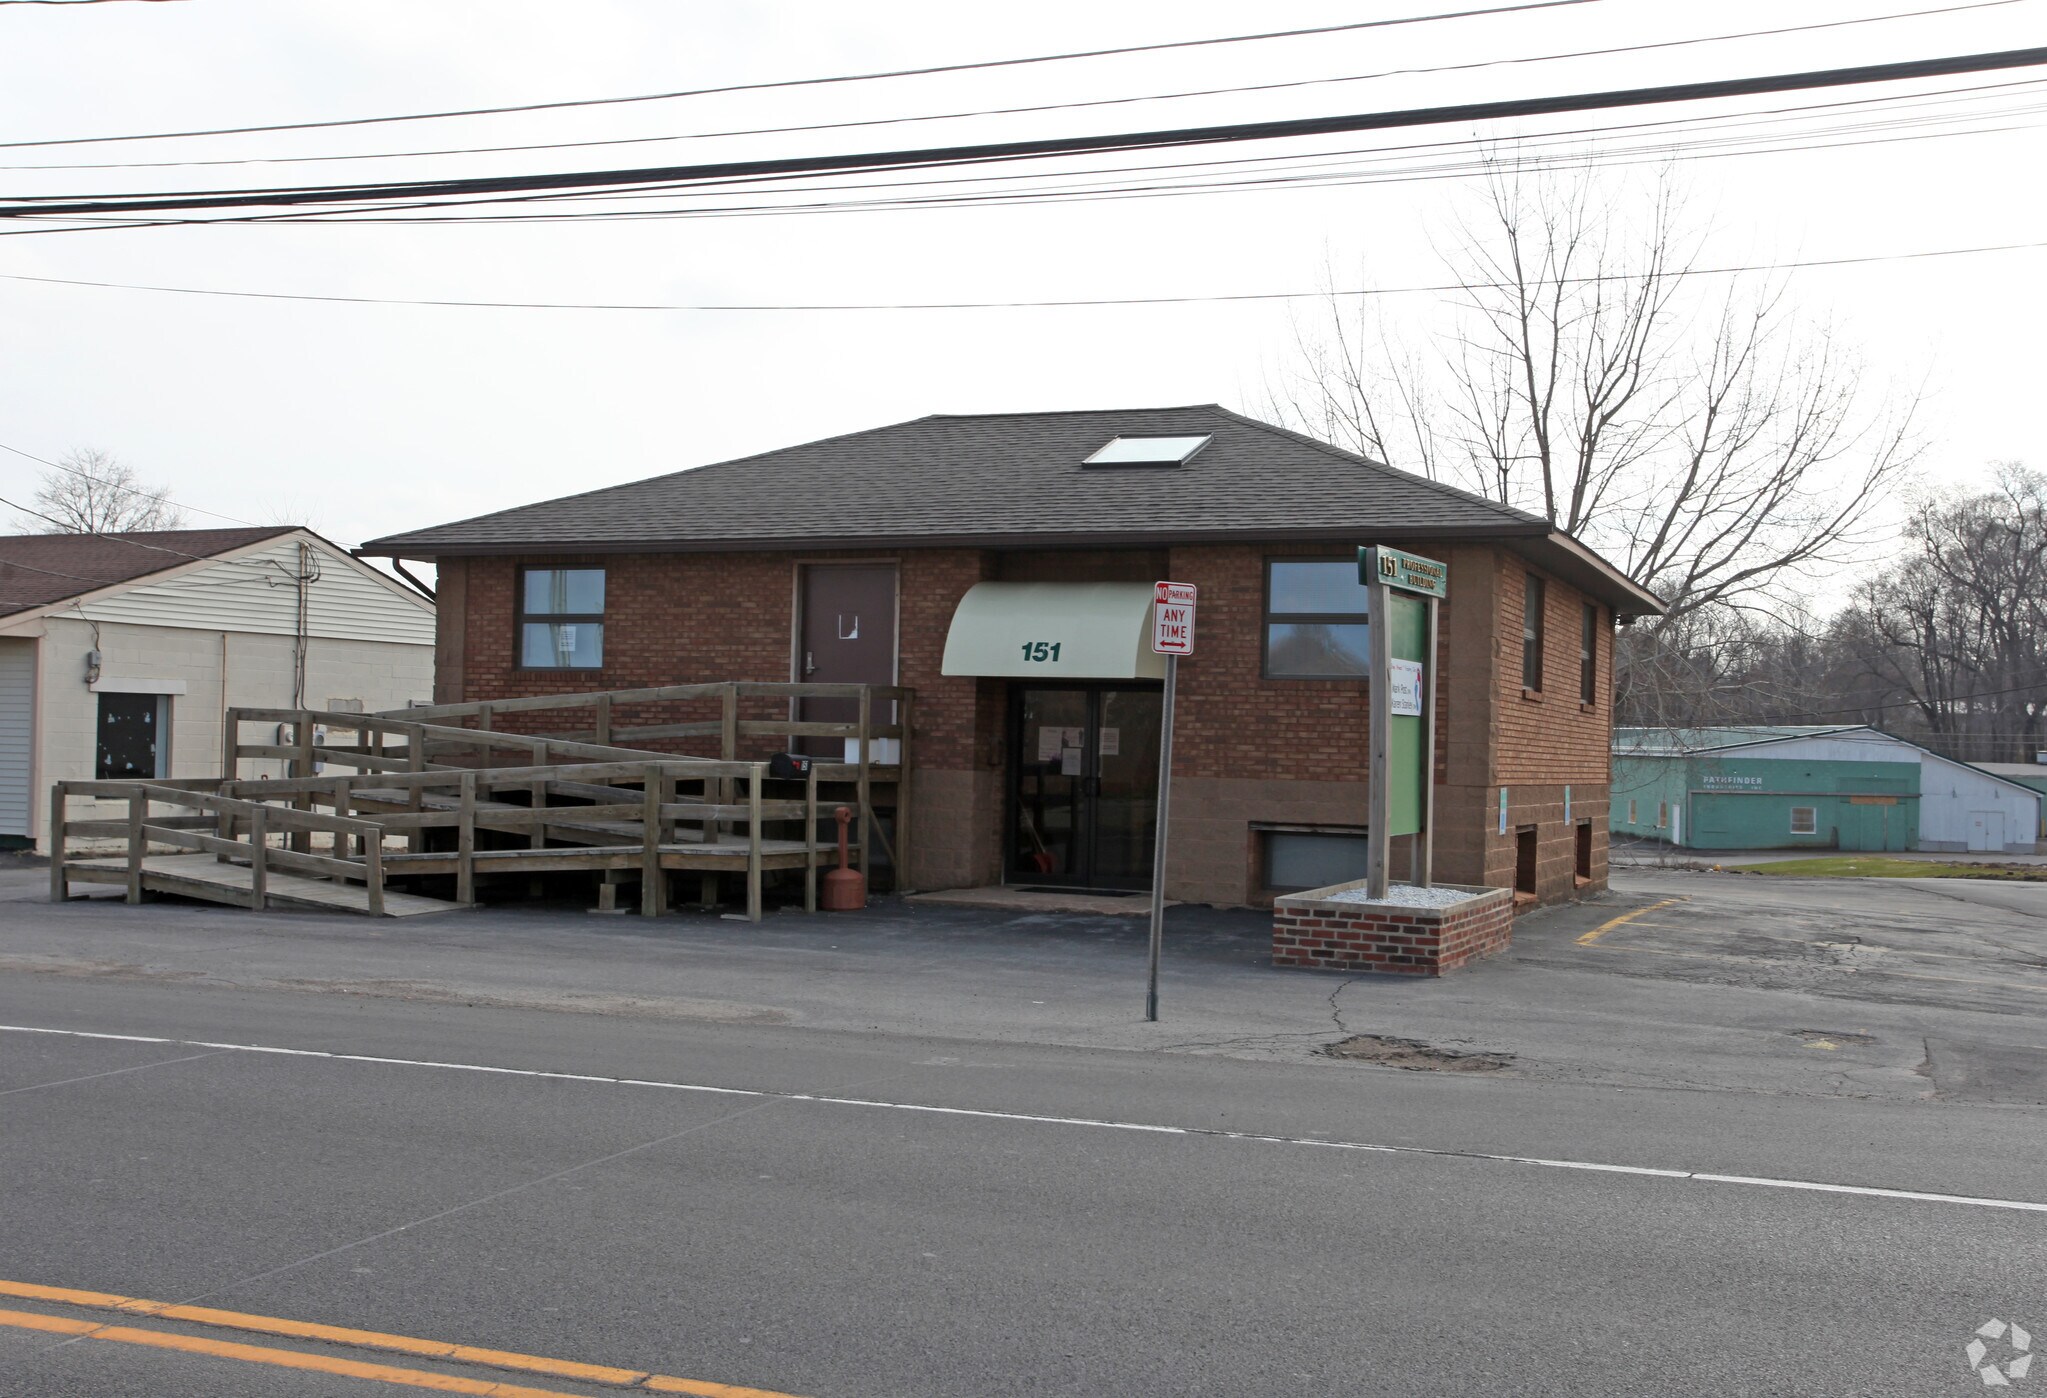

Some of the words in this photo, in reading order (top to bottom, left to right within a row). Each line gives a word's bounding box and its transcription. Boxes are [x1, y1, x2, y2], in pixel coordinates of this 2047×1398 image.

[1382, 556, 1398, 577] 151
[1402, 558, 1443, 578] PROFESSIONAL
[1408, 573, 1437, 590] BUILDING
[1156, 586, 1168, 601] NO
[1168, 589, 1194, 601] PARKING
[1163, 608, 1186, 622] ANY
[1161, 624, 1187, 639] TIME
[1021, 641, 1061, 663] 151
[1703, 776, 1762, 785] PATHFINDER
